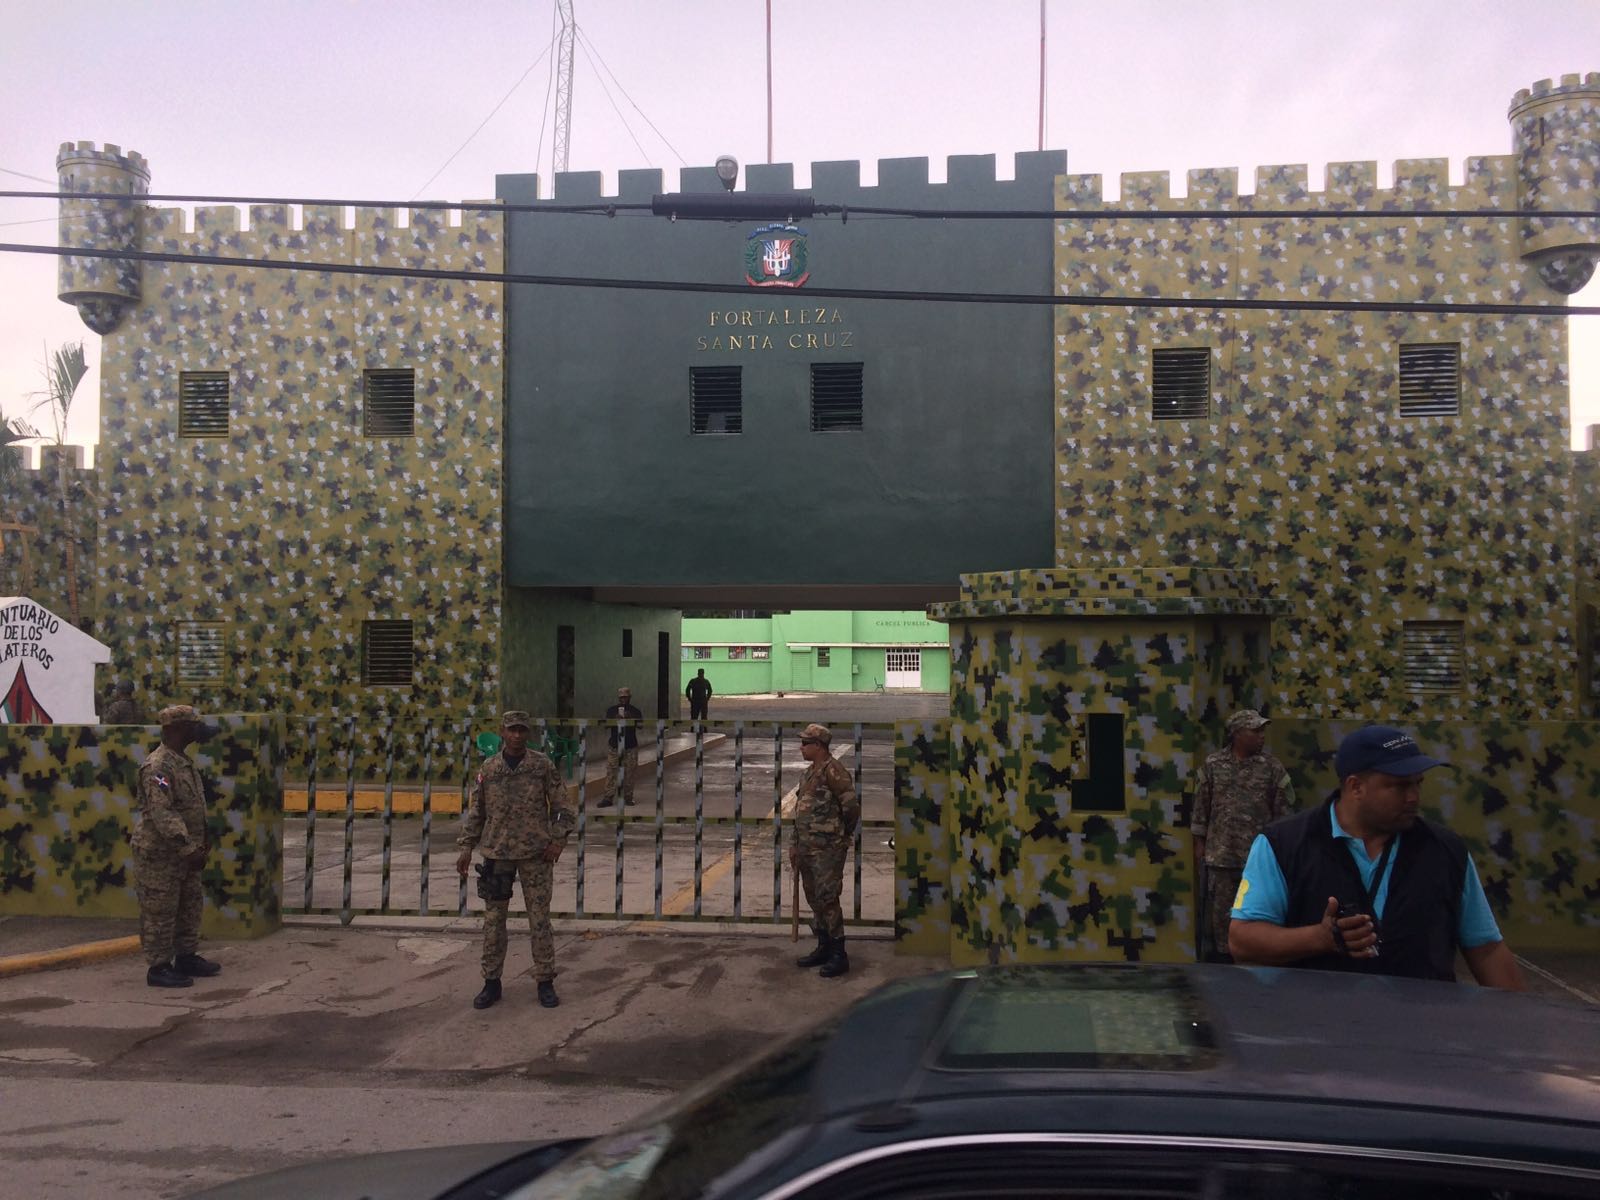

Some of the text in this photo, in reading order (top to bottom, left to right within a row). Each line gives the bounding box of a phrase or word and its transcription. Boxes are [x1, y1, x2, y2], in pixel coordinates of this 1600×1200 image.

[709, 308, 842, 327] FORTALEZA
[697, 331, 853, 351] SANTA CRUZ
